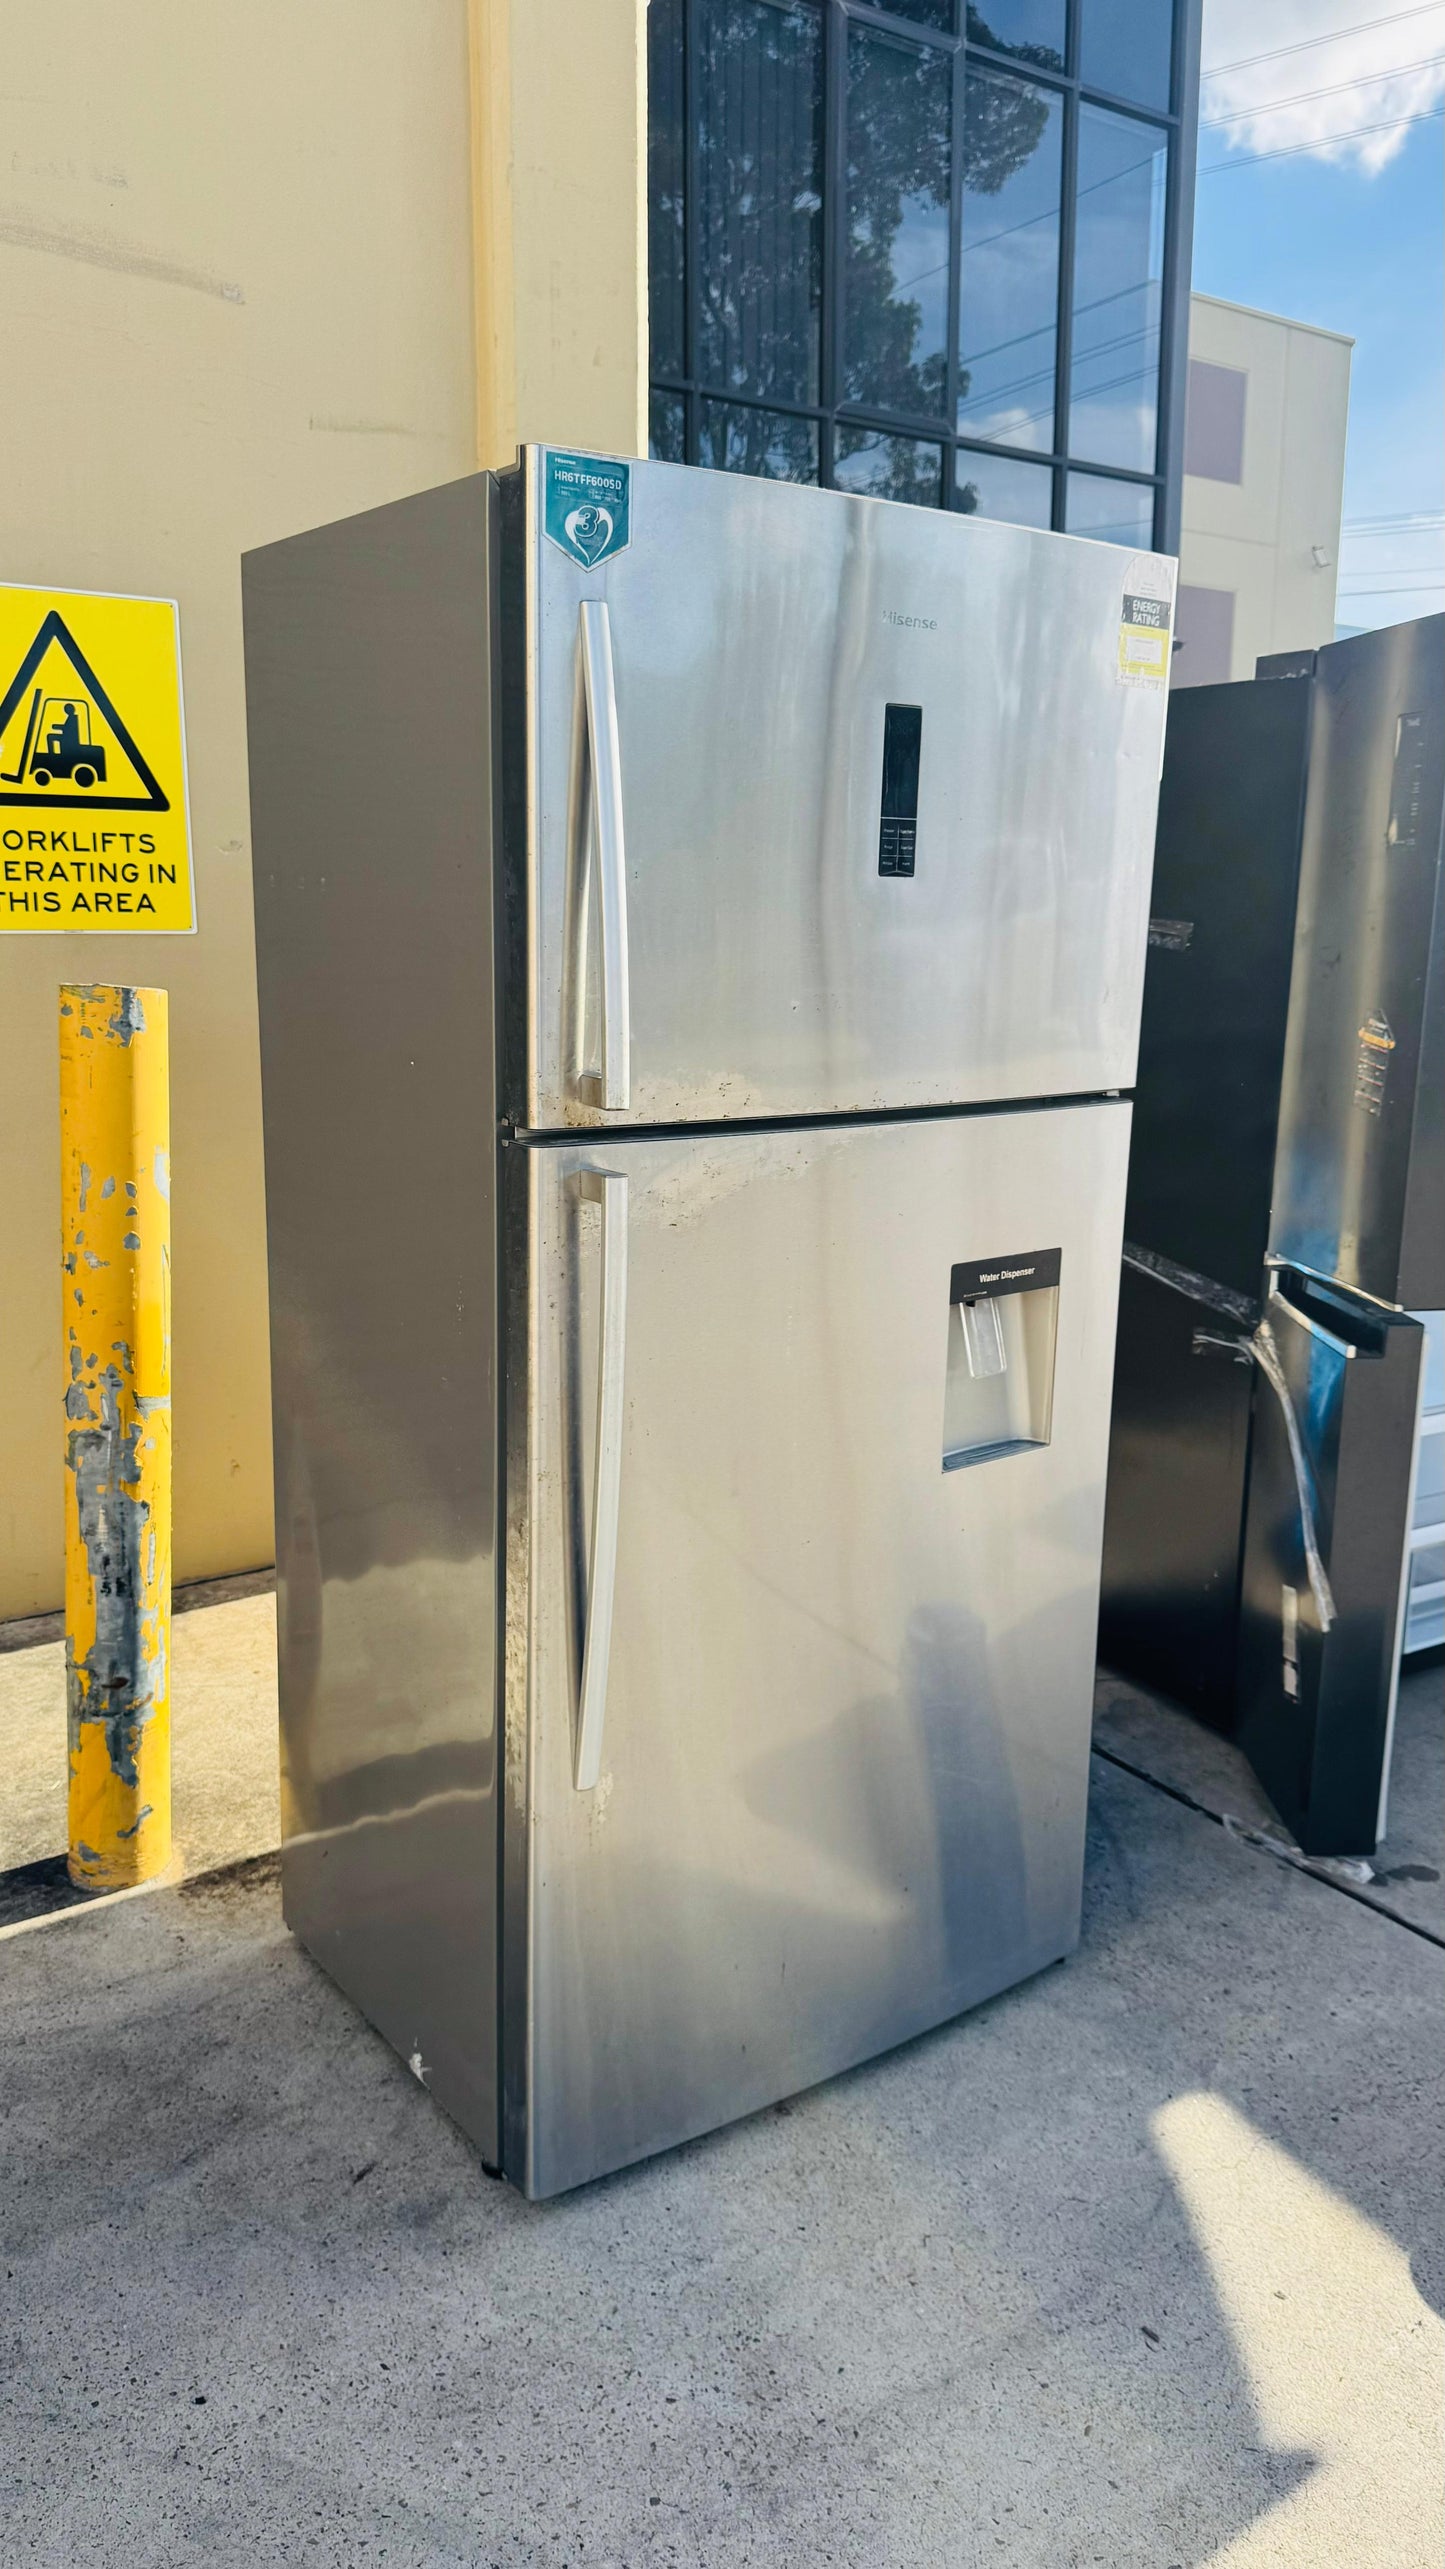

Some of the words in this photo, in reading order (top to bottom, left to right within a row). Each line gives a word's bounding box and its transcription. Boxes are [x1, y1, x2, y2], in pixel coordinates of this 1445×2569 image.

[554, 470, 622, 490] HR6TFF600SD
[1132, 599, 1160, 614] ENERGY
[1132, 611, 1160, 627] RATING
[149, 864, 176, 884] IN
[71, 892, 157, 913] AREA
[979, 1273, 1000, 1283] Water
[1001, 1267, 1036, 1279] Dispenser
